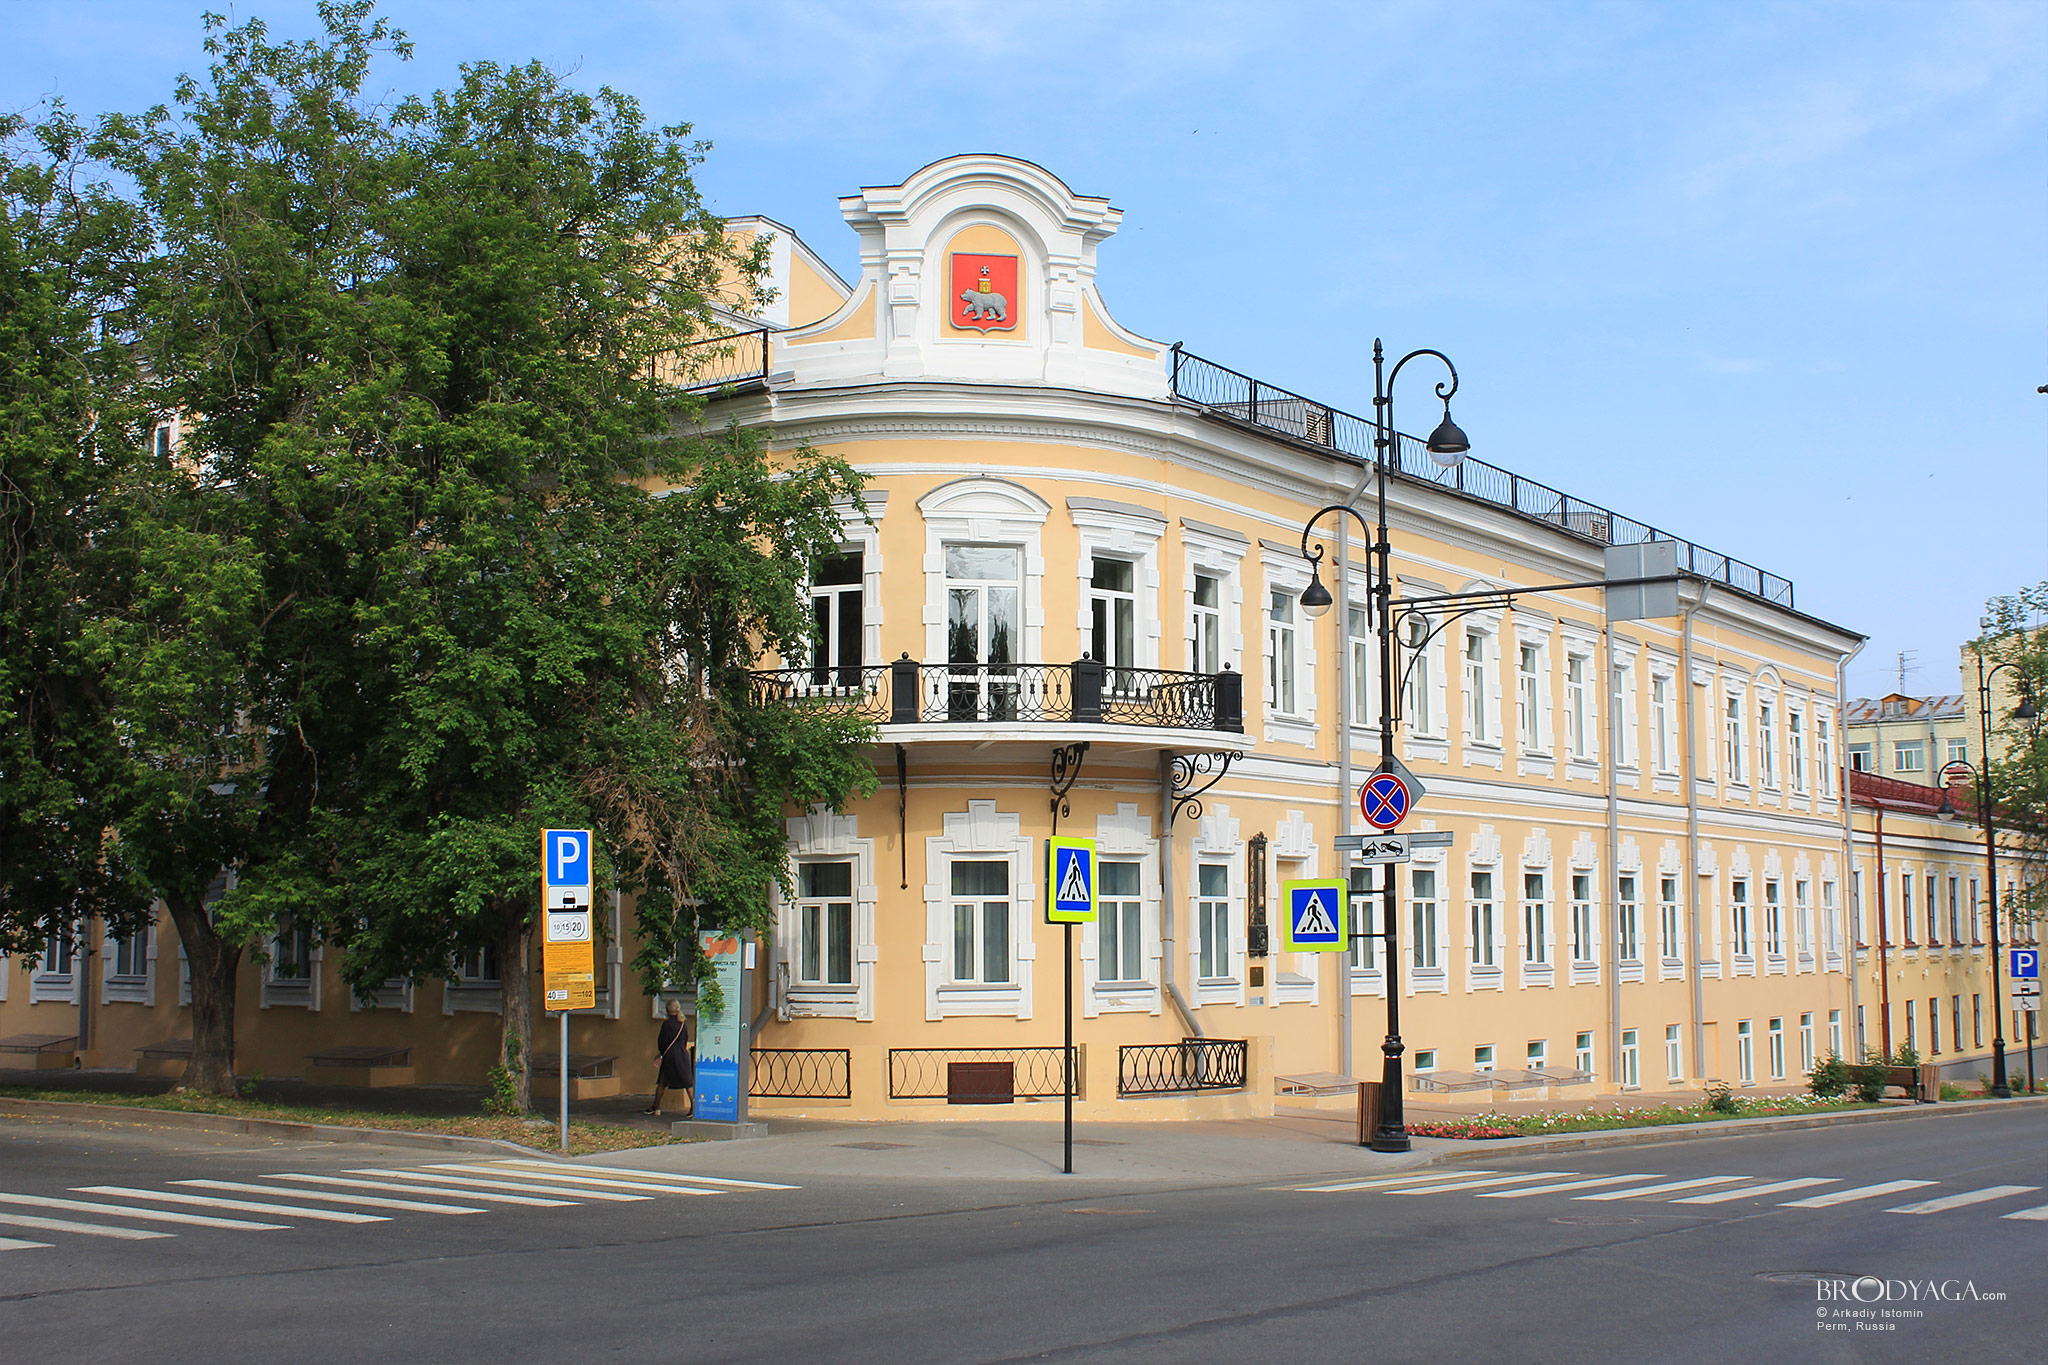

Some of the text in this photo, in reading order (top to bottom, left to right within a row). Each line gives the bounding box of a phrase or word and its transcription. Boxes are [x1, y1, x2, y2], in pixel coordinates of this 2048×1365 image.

[557, 836, 581, 879] P
[562, 922, 570, 931] 15
[572, 921, 582, 932] 20
[2017, 952, 2034, 975] P
[547, 991, 557, 1000] 40
[582, 990, 593, 998] 102
